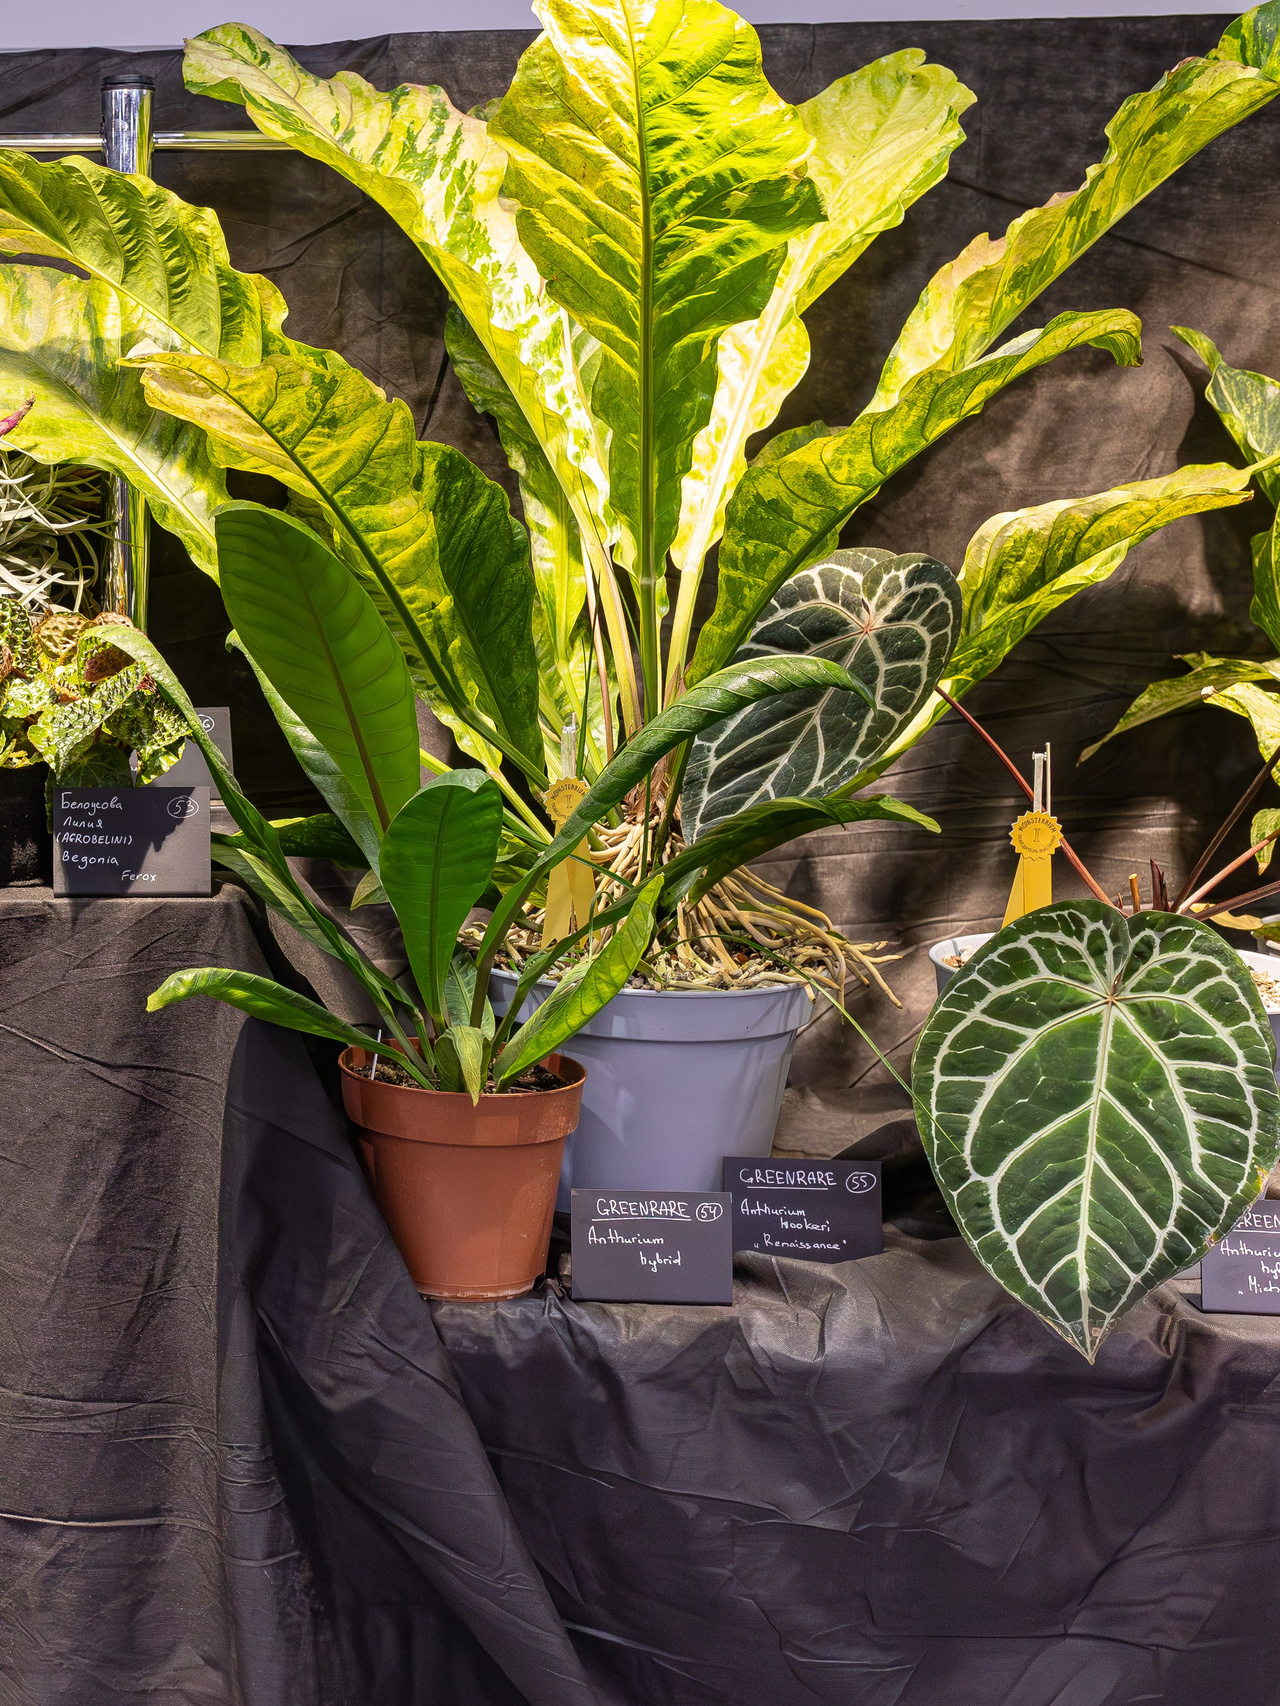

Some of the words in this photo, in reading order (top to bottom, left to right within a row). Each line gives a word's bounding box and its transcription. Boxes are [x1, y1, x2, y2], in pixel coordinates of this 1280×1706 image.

[61, 791, 123, 816] Белоусова
[63, 816, 103, 829] Лилия
[56, 831, 133, 846] (AGROBELINI)
[61, 850, 120, 870] Begonia
[121, 869, 157, 882] Ferox
[739, 1168, 837, 1186] GREENRARE
[596, 1198, 691, 1219] GREENRARE
[740, 1198, 806, 1217] Anthurium
[588, 1225, 664, 1245] Anthurium
[639, 1250, 682, 1272] hybrid
